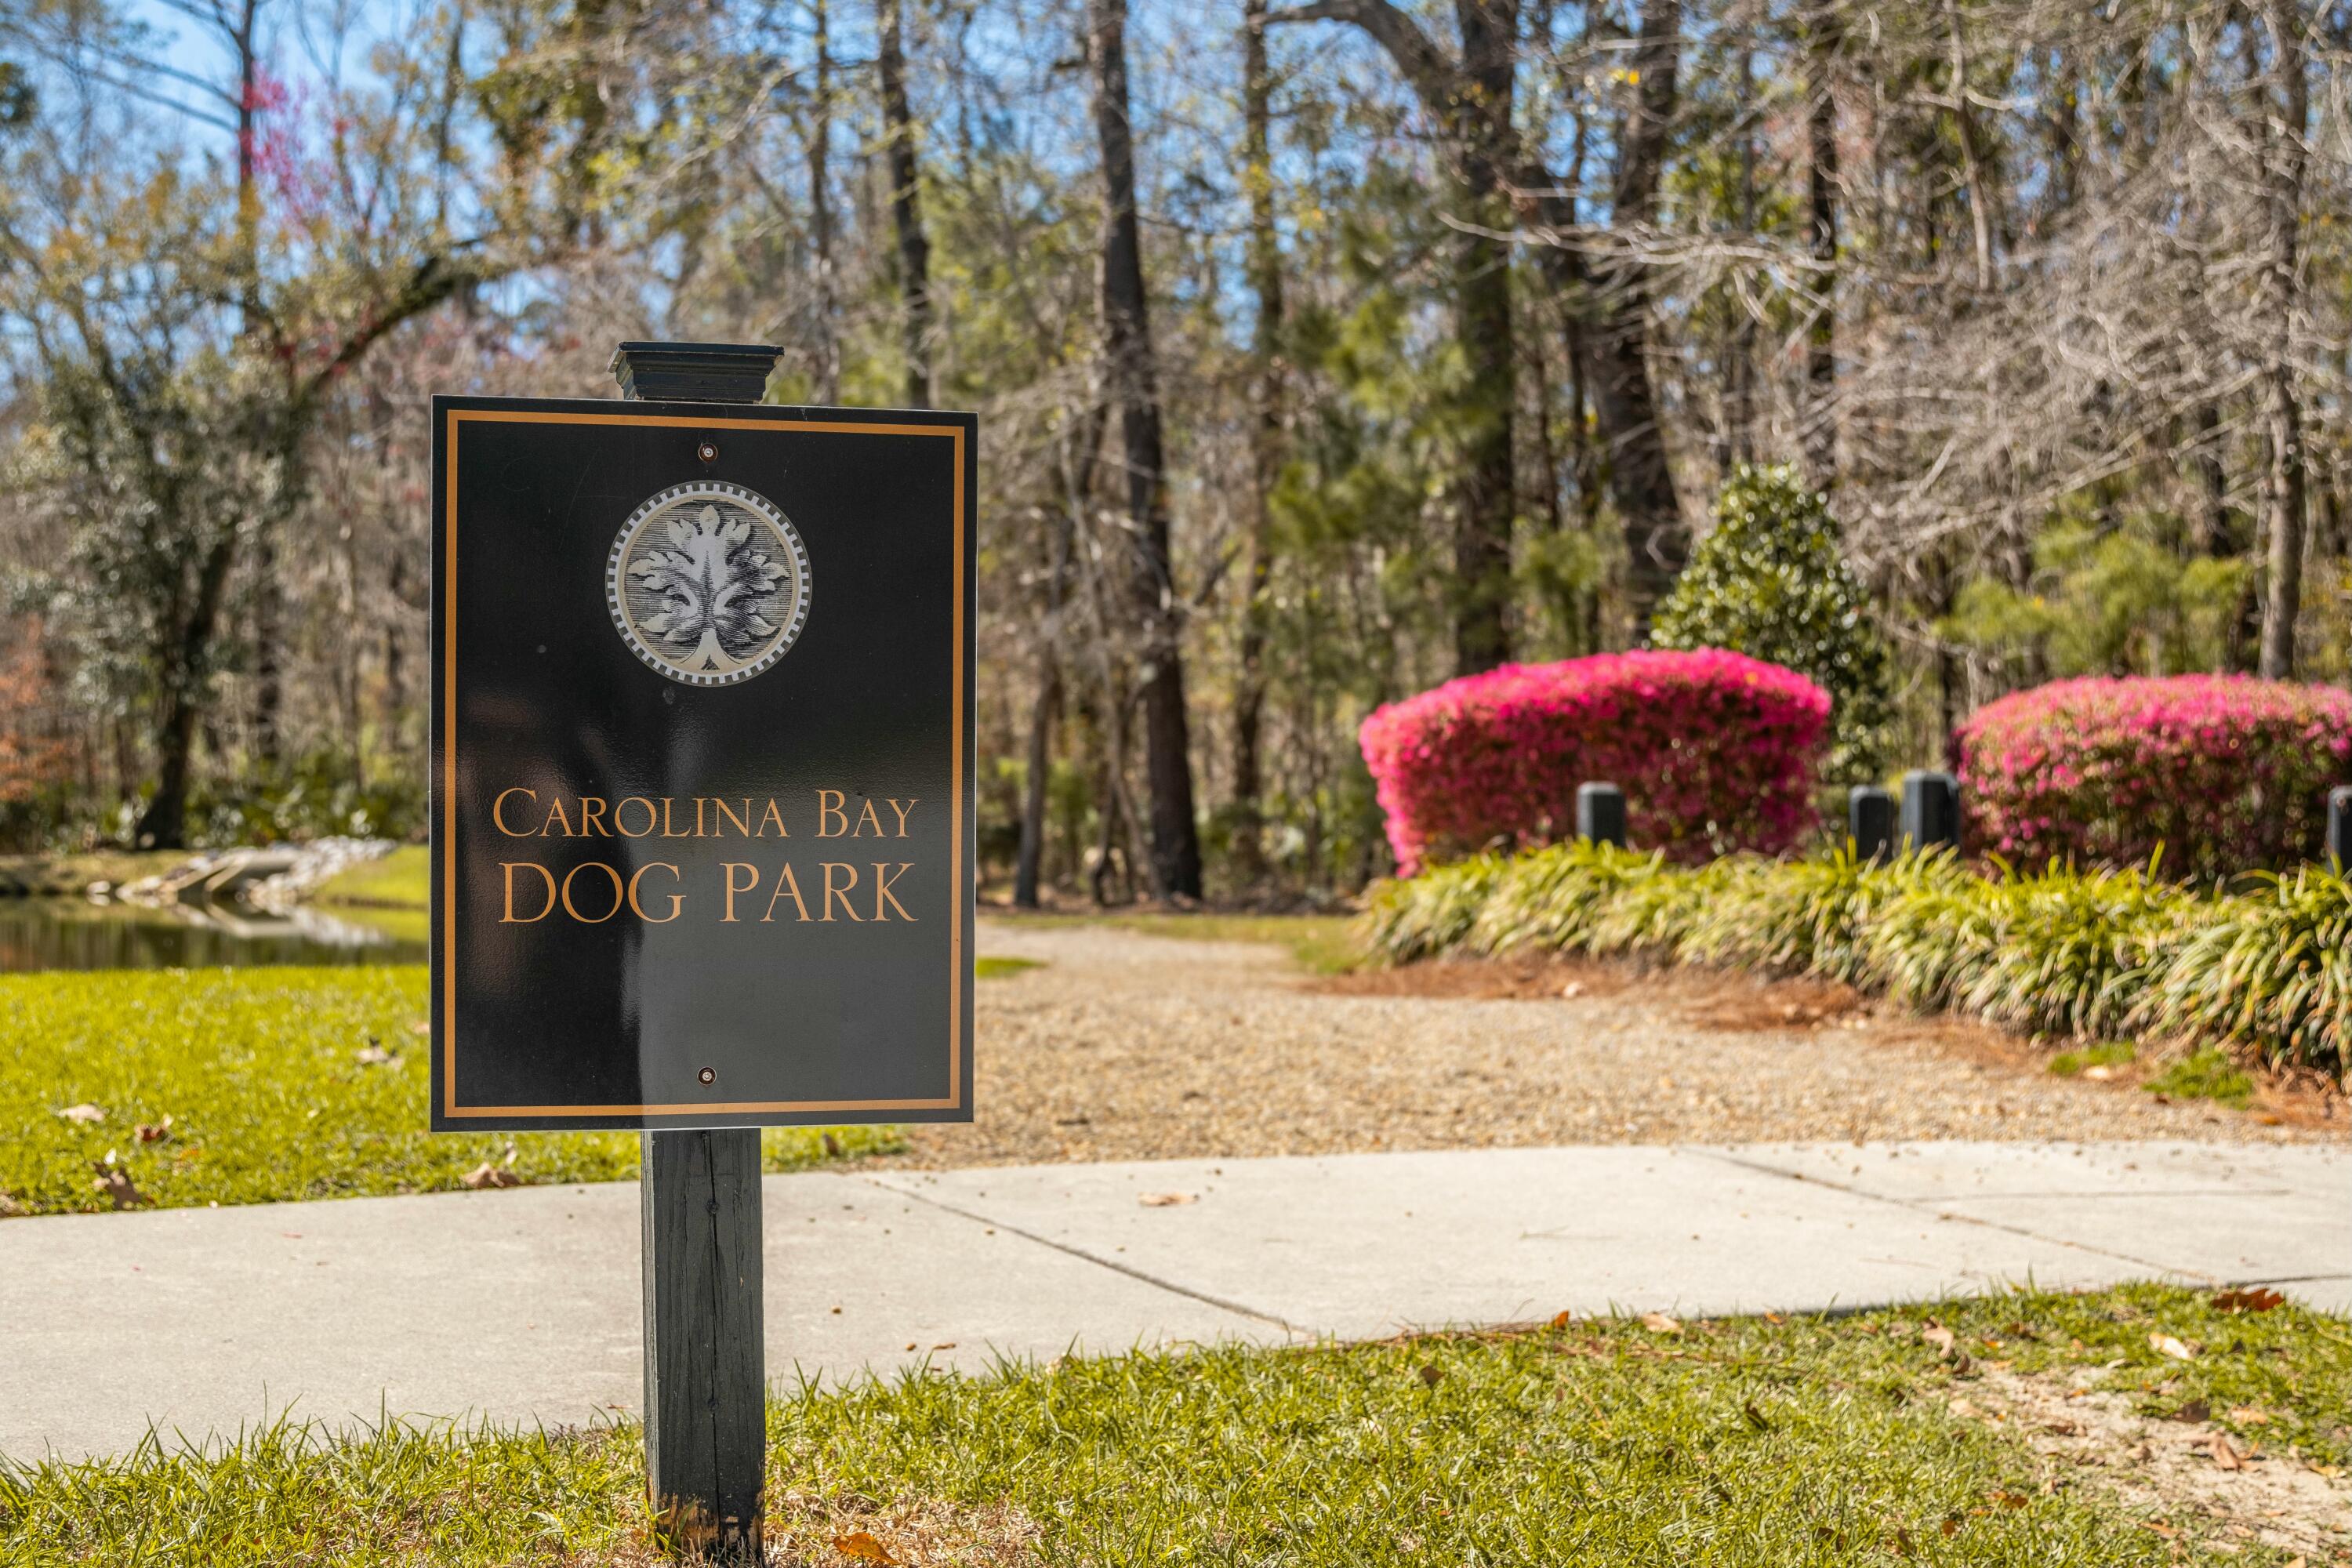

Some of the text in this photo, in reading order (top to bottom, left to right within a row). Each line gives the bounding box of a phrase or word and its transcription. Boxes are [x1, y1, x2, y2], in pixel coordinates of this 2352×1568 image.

[493, 787, 920, 837] CAROLINA BAY
[498, 862, 920, 923] DOG PARK
